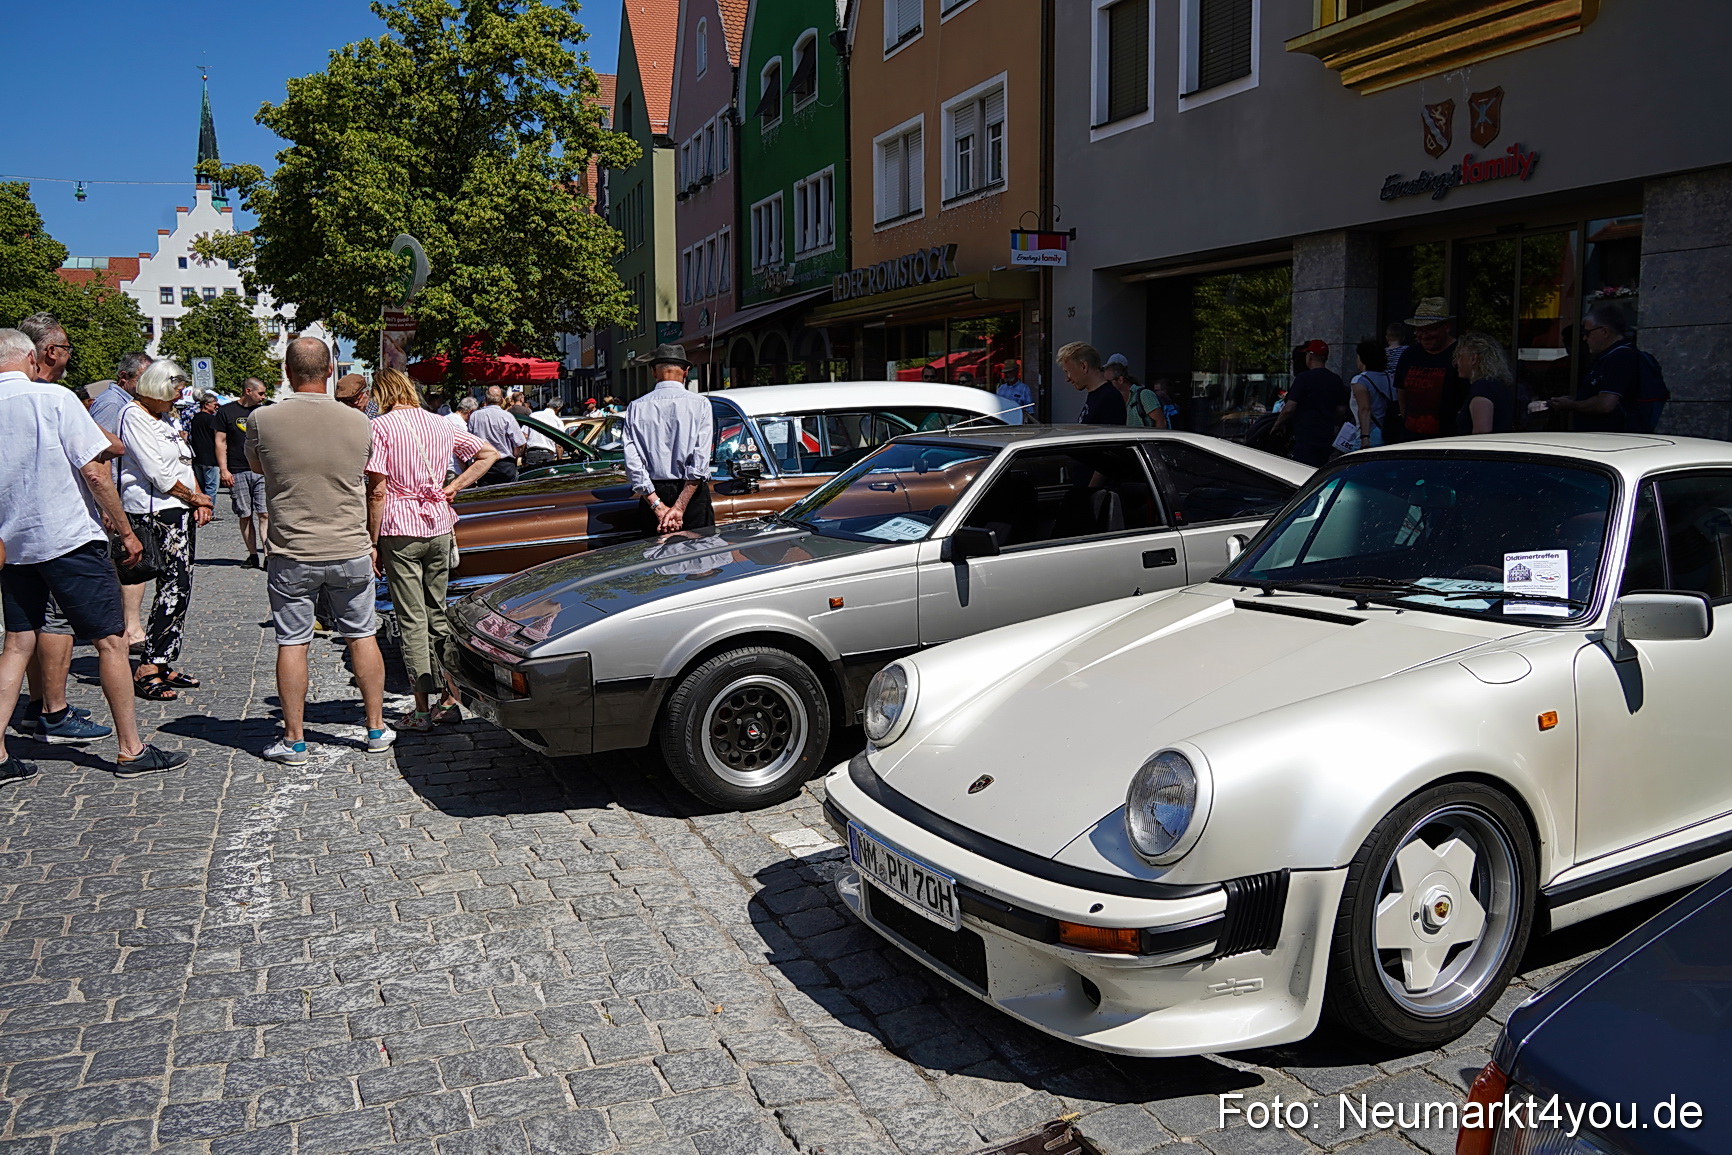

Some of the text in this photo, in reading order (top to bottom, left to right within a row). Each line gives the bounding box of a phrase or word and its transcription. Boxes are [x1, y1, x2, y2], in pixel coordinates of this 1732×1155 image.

[1380, 143, 1538, 200] Ernsting's family
[1042, 253, 1062, 264] family
[833, 269, 863, 303] LEDER
[1067, 306, 1076, 318] 35
[903, 526, 922, 534] 114
[1505, 553, 1560, 561] Oldtimertreffen
[858, 833, 878, 875] NM
[886, 853, 909, 895] PW
[913, 867, 954, 918] 70H
